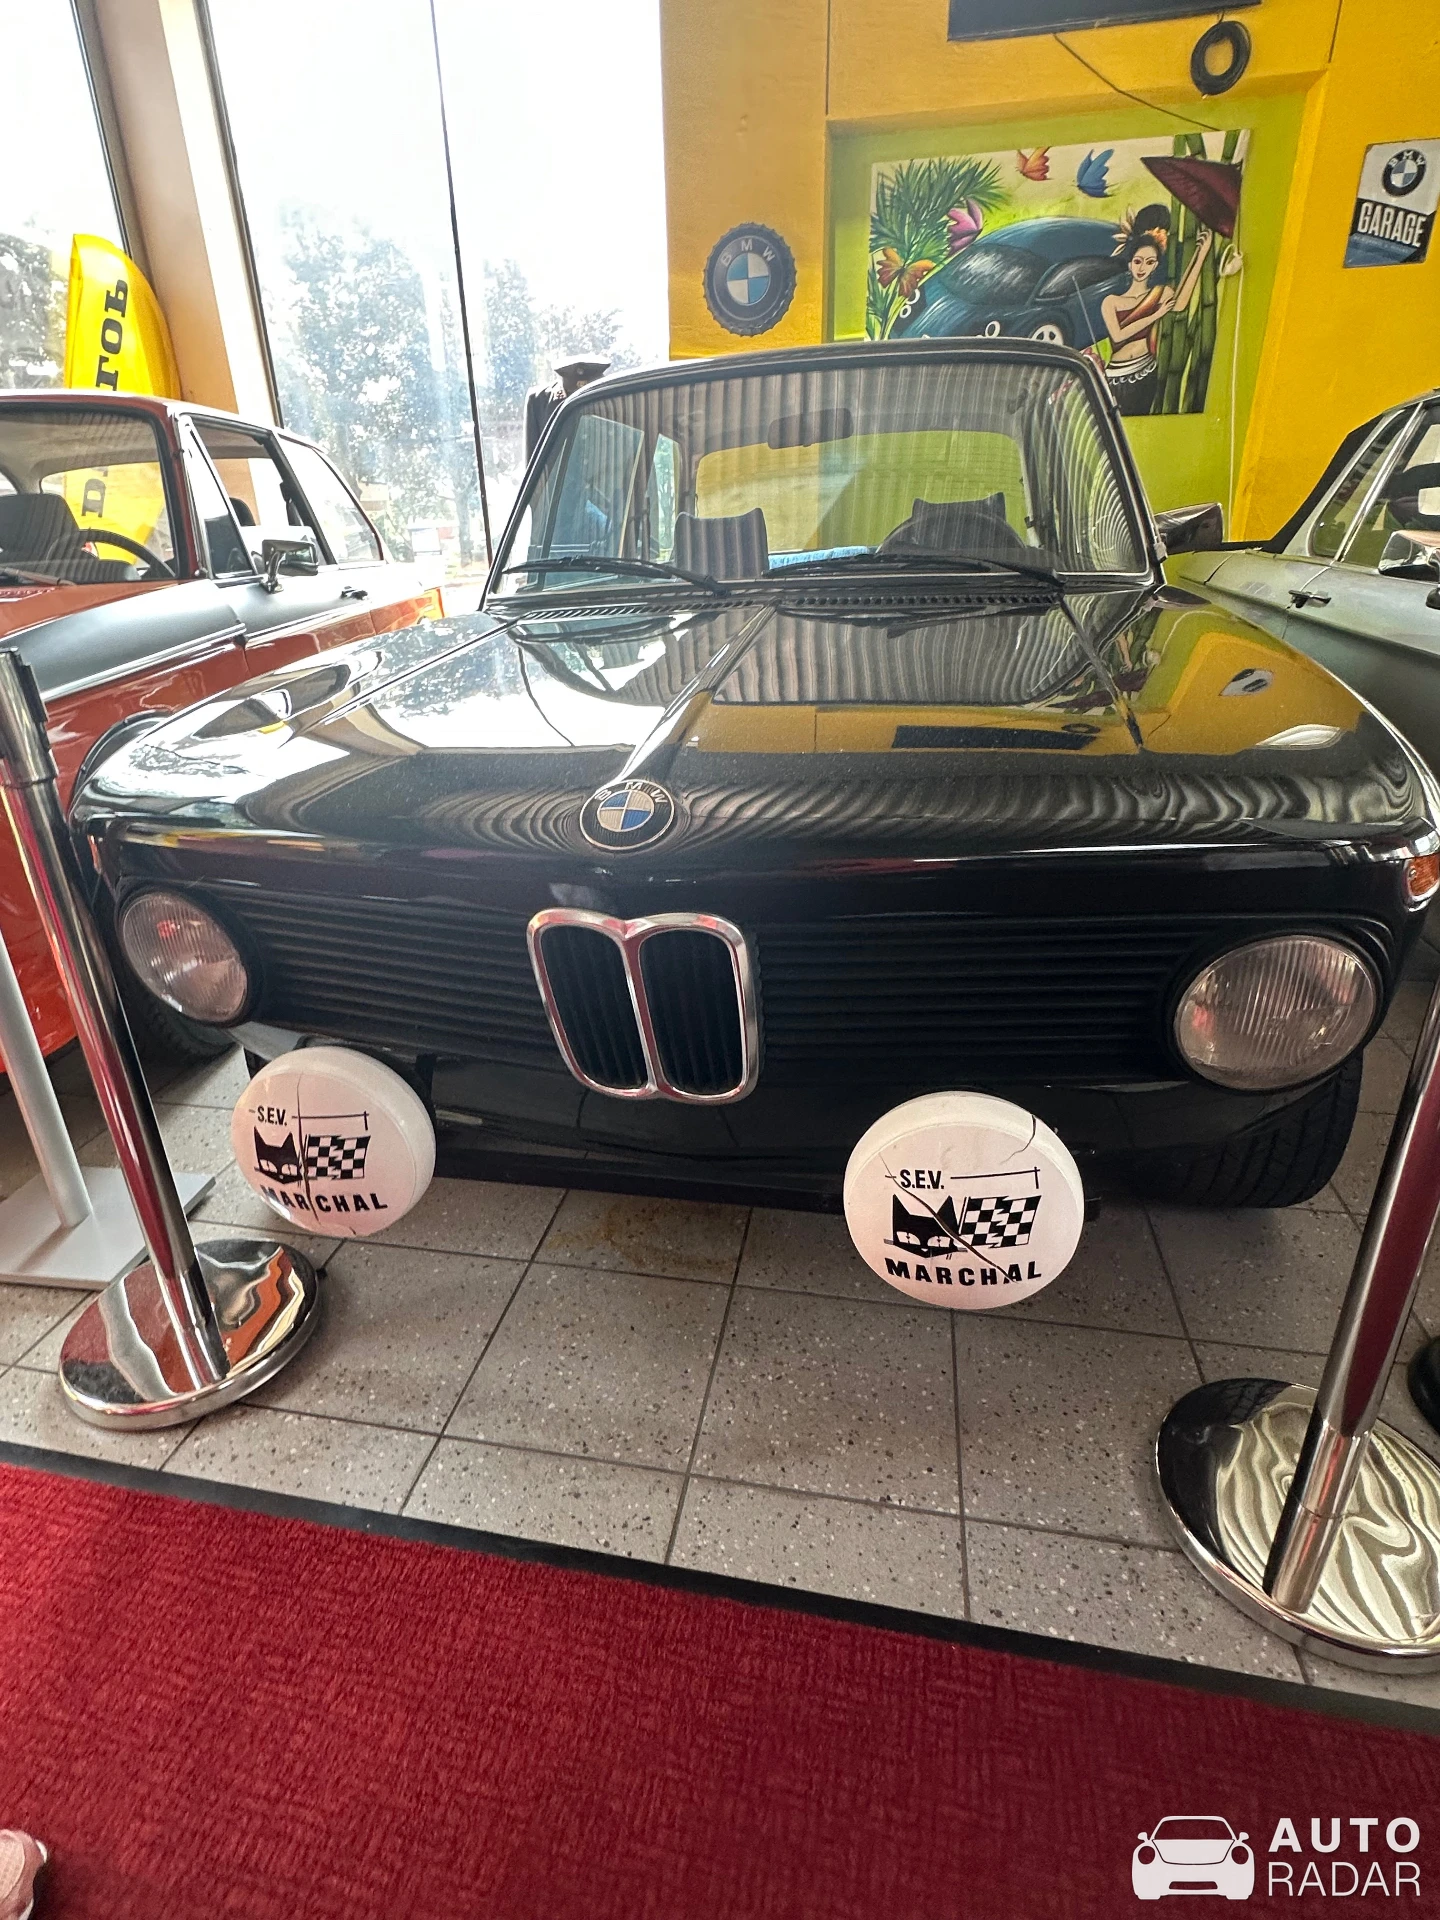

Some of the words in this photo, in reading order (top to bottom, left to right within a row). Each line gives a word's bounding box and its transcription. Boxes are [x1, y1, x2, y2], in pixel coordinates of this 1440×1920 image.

[1389, 150, 1425, 168] BMW
[1357, 201, 1427, 248] GARAGE
[721, 239, 776, 267] BMW
[594, 781, 668, 803] BMW
[257, 1105, 288, 1127] S.E.V.
[899, 1169, 945, 1190] S.E.V.
[260, 1184, 389, 1213] MARCHAL
[884, 1257, 1043, 1287] MARCHAL
